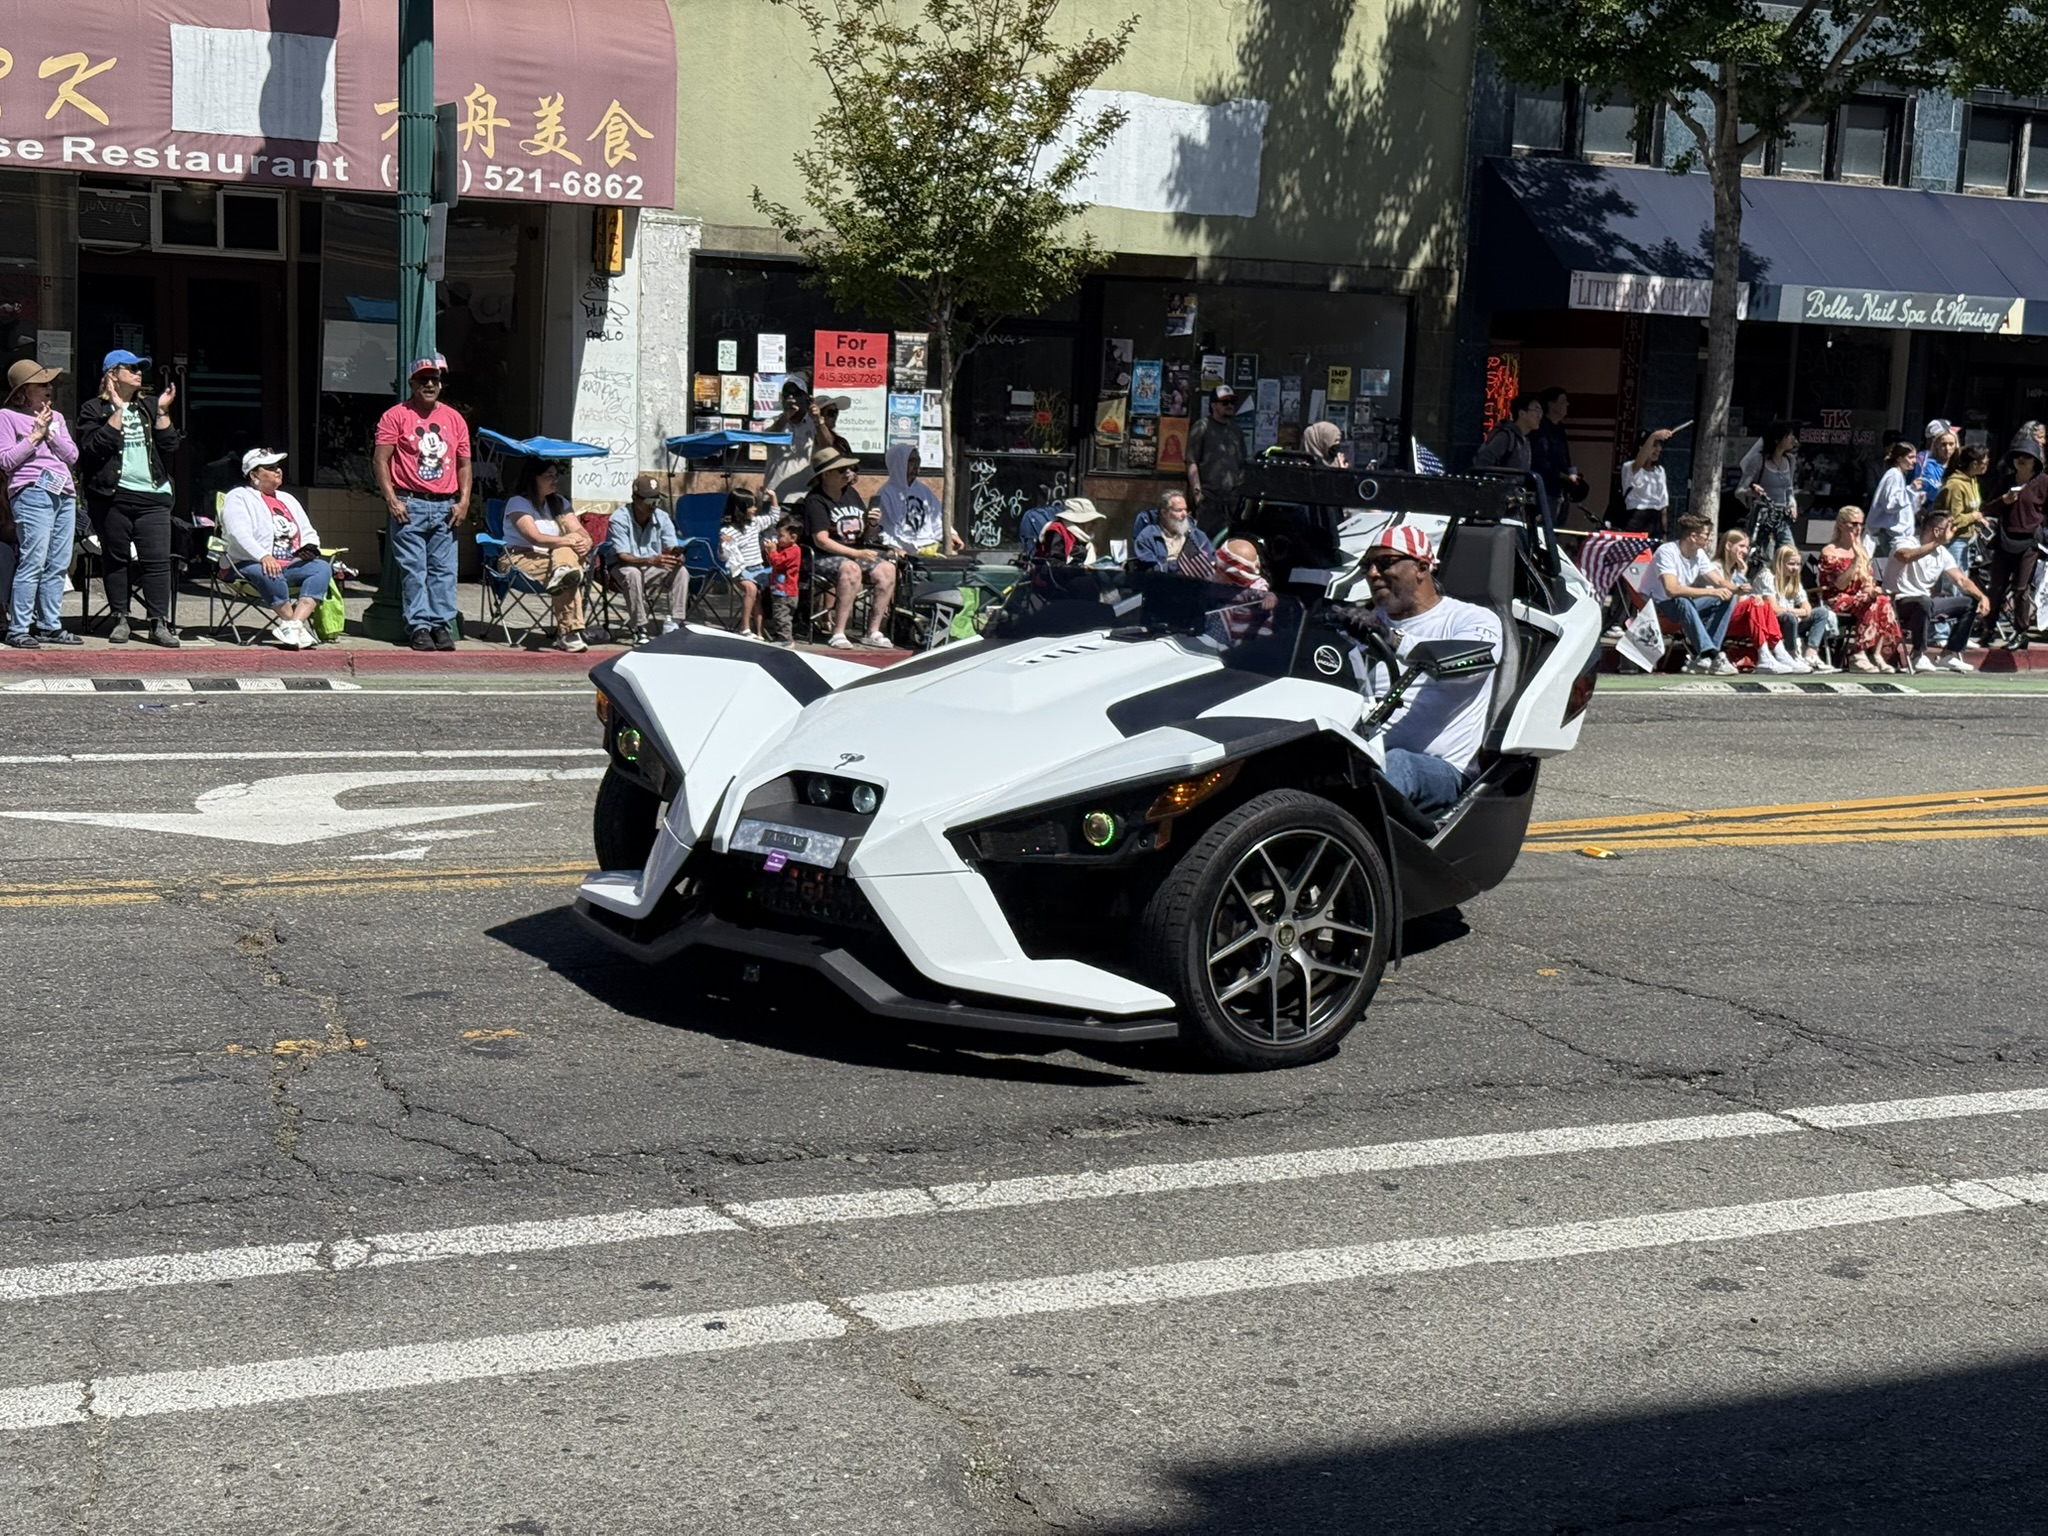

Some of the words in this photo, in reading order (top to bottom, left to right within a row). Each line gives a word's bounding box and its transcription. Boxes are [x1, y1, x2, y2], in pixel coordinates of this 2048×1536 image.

[63, 136, 349, 182] Restaurant
[484, 164, 644, 200] 521-6862
[1577, 278, 1630, 308] LITTLE
[1806, 289, 1854, 319] Bella
[1854, 293, 1896, 322] Nail
[1897, 299, 1926, 327] Spa
[1930, 297, 1946, 325] &
[1946, 299, 2000, 332] Waxing
[836, 334, 868, 350] For
[825, 351, 877, 369] Lease
[818, 372, 883, 384] 415.395.7262
[1820, 409, 1852, 428] TK
[871, 441, 882, 450] JLL
